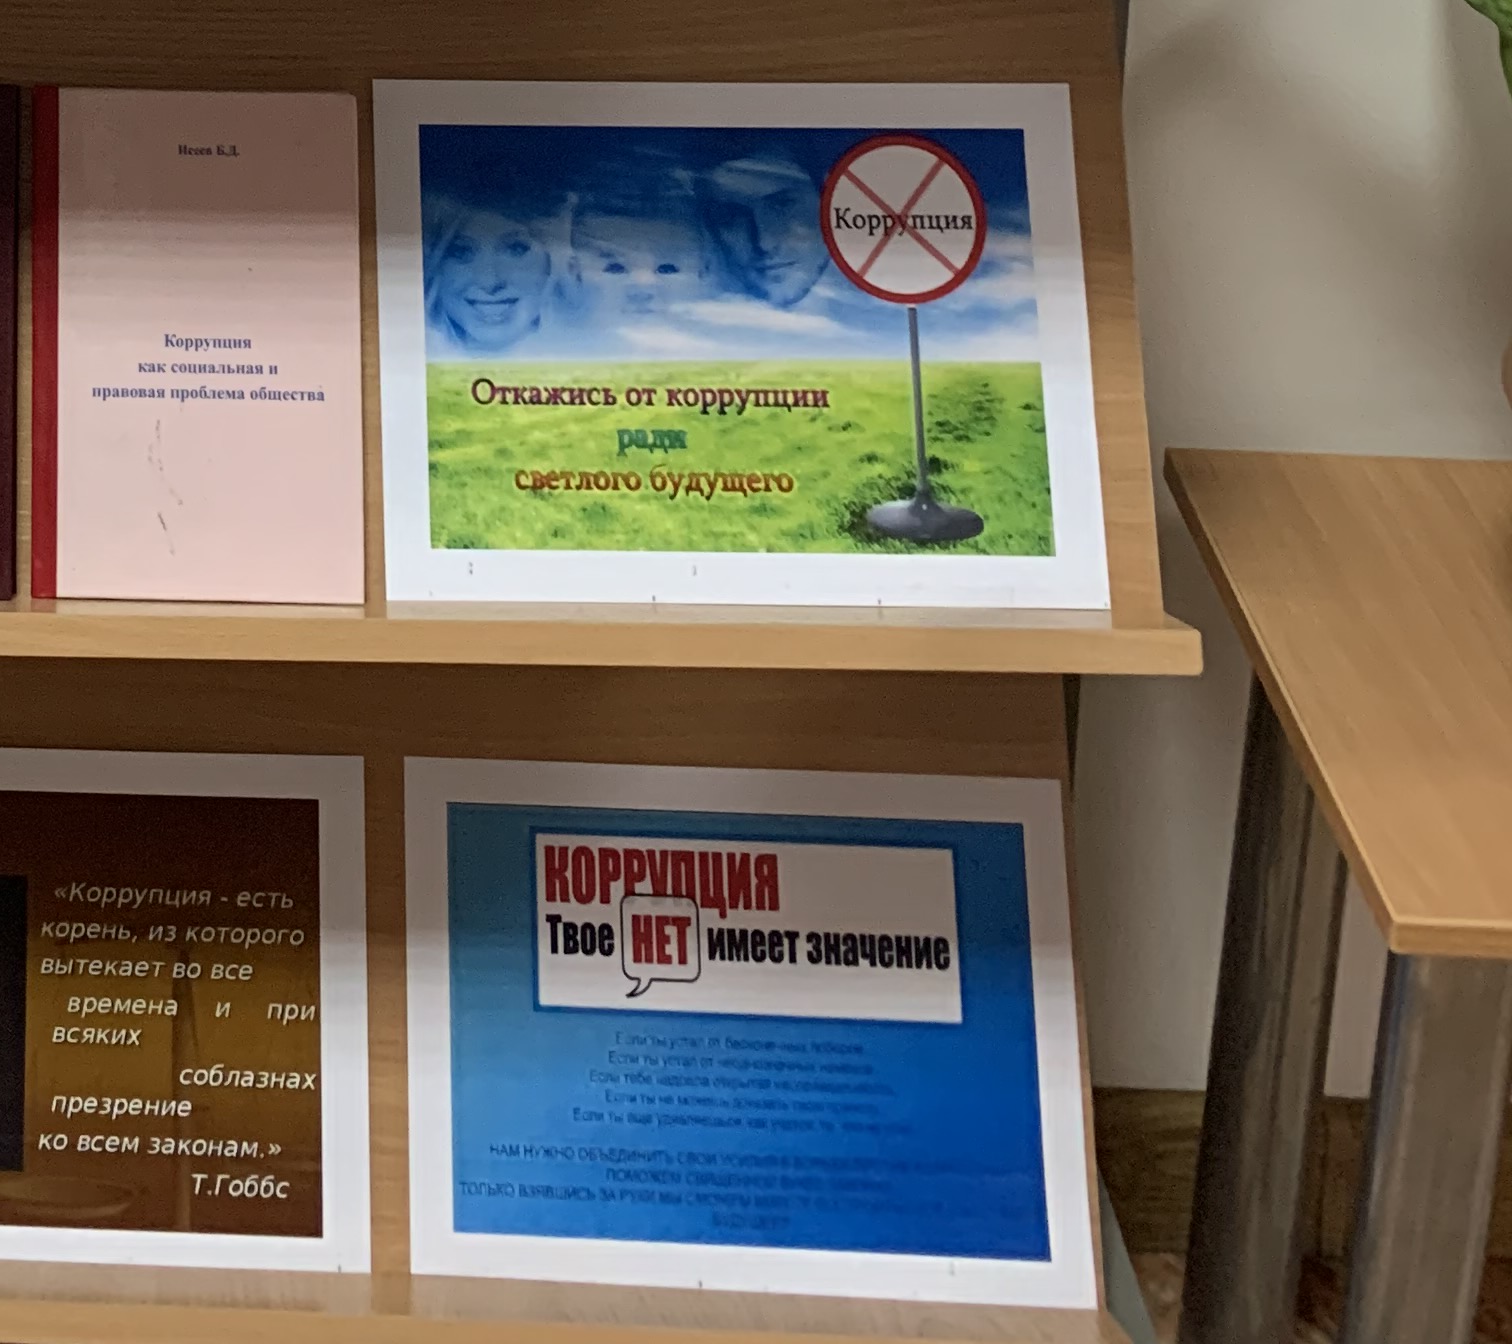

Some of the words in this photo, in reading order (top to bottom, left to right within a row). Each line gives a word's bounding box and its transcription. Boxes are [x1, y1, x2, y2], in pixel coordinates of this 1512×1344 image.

[833, 207, 974, 237] Коррупция
[164, 333, 252, 351] Коррупция
[138, 362, 166, 374] как
[171, 363, 263, 376] социальная
[92, 386, 165, 401] правовая
[170, 386, 244, 402] проблема
[250, 387, 325, 402] общества
[471, 378, 616, 407] Откажись
[666, 385, 830, 415] коррупции
[617, 426, 687, 456] ради
[514, 468, 640, 493] светлого
[650, 462, 795, 499] будущего
[544, 845, 780, 919] КОРРУПЦИЯ
[54, 882, 211, 908] «Коррупция
[237, 890, 294, 909] есть
[41, 920, 138, 942] корень,
[149, 924, 176, 941] из
[186, 925, 304, 949] которого
[546, 913, 615, 957] Твое
[632, 913, 690, 965] НЕТ
[707, 927, 799, 965] имеет
[805, 932, 951, 971] значение
[41, 958, 165, 978] вытекает
[172, 962, 201, 979] во
[211, 963, 253, 981] все
[67, 997, 178, 1016] времена
[215, 1001, 231, 1018] и
[267, 1003, 316, 1025] при
[52, 1026, 142, 1045] всяких
[179, 1065, 316, 1090] соблазнах
[50, 1095, 192, 1120] презрение
[38, 1134, 68, 1151] ко
[77, 1134, 139, 1153] всем
[148, 1136, 282, 1158] законам.»
[192, 1173, 290, 1199] Т.Гоббс
